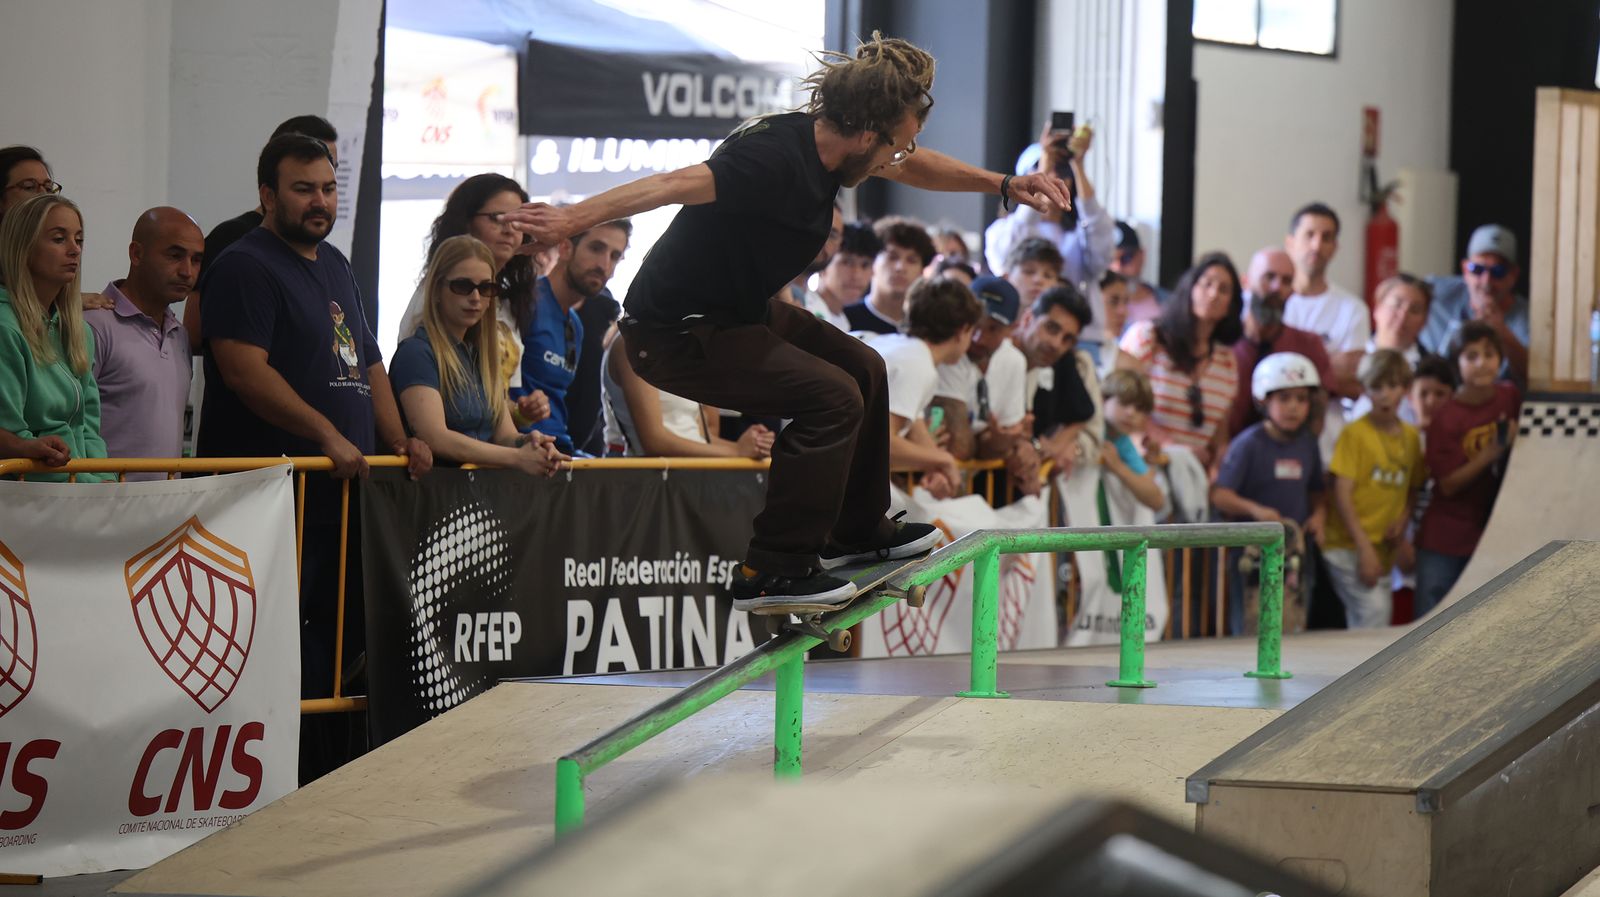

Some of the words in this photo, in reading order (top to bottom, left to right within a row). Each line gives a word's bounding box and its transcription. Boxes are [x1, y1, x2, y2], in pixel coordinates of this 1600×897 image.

[642, 72, 793, 118] VOLCOM
[421, 124, 452, 144] CNS
[530, 138, 561, 174] &
[564, 557, 605, 588] Real
[610, 551, 702, 586] Federación
[454, 611, 522, 662] RFEP
[563, 595, 758, 676] PATINA
[0, 738, 61, 831] S
[128, 721, 264, 817] CNS
[147, 818, 184, 832] NACIONAL
[185, 818, 198, 829] DE
